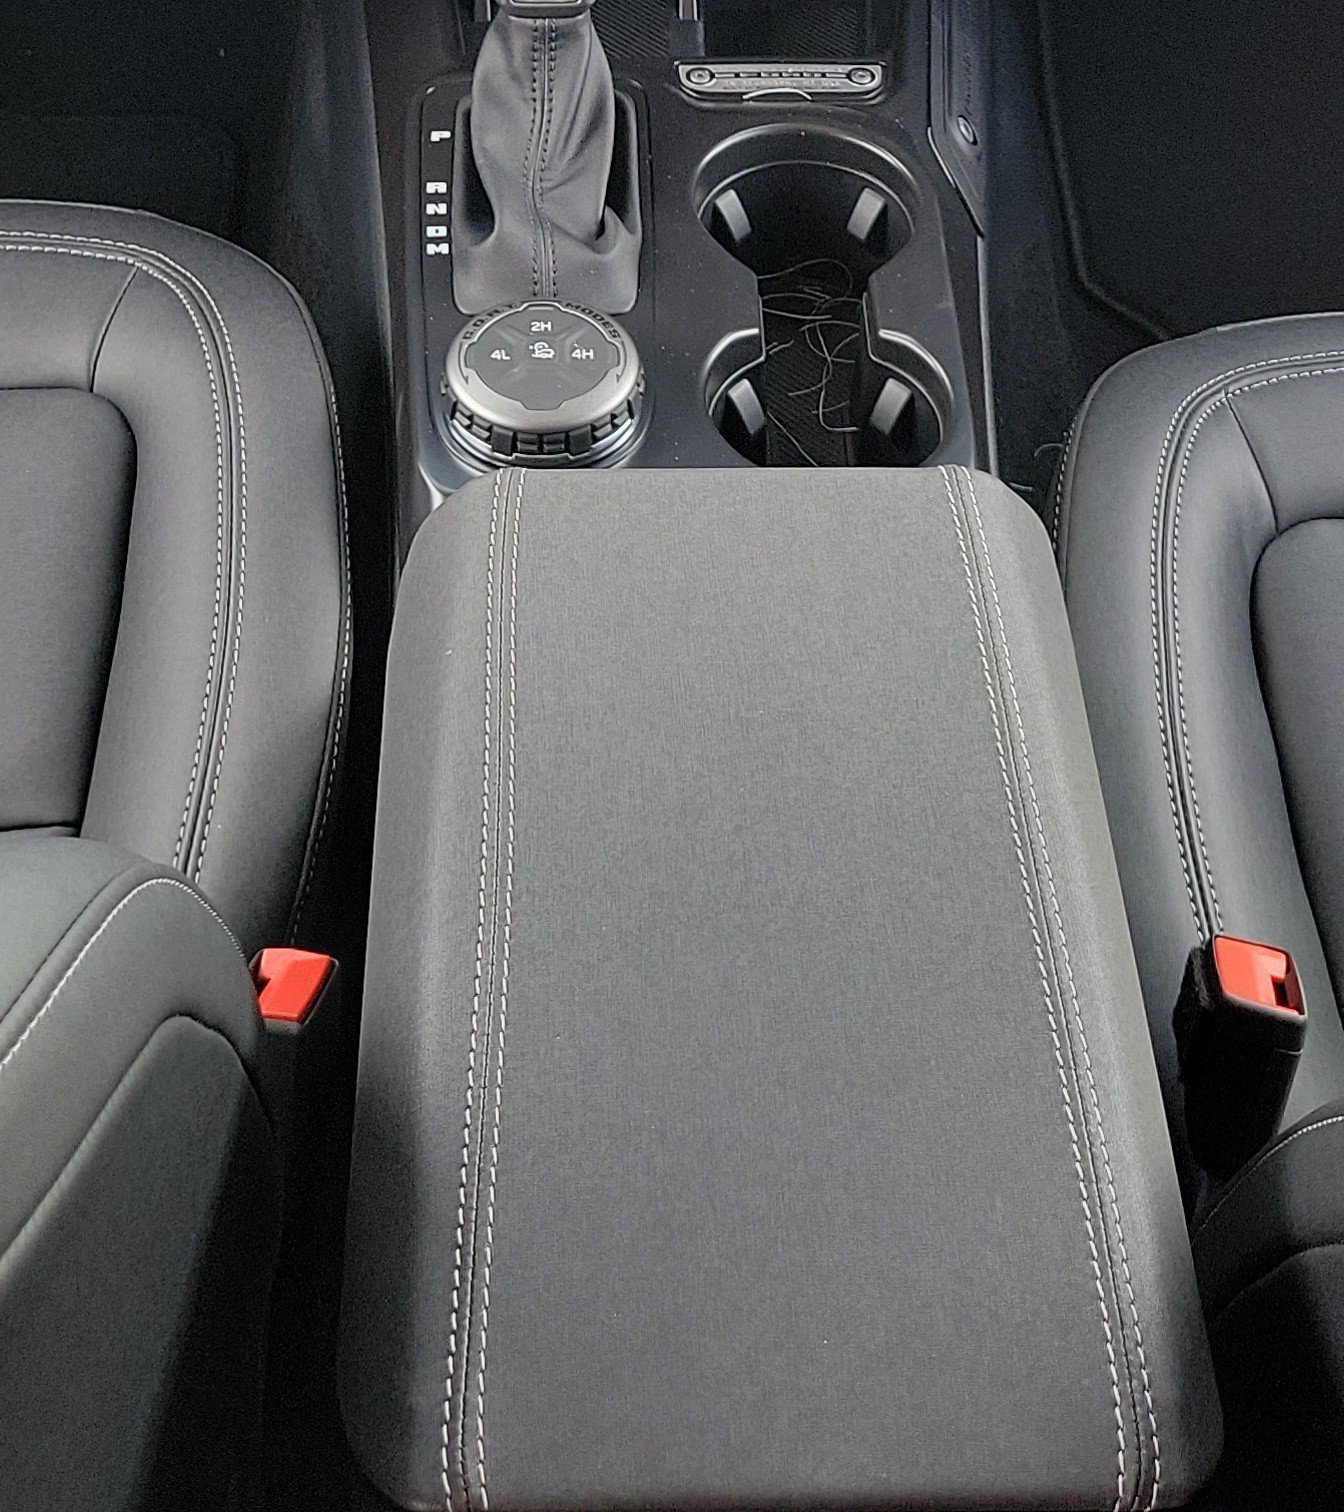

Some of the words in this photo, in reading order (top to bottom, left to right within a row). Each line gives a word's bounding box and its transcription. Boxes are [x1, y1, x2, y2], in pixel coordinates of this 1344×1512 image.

[430, 130, 451, 142] P
[426, 202, 447, 215] N
[426, 242, 449, 255] M
[530, 321, 552, 332] 2H
[565, 302, 622, 339] MODES
[490, 349, 511, 361] 4L
[571, 349, 594, 360] 4H
